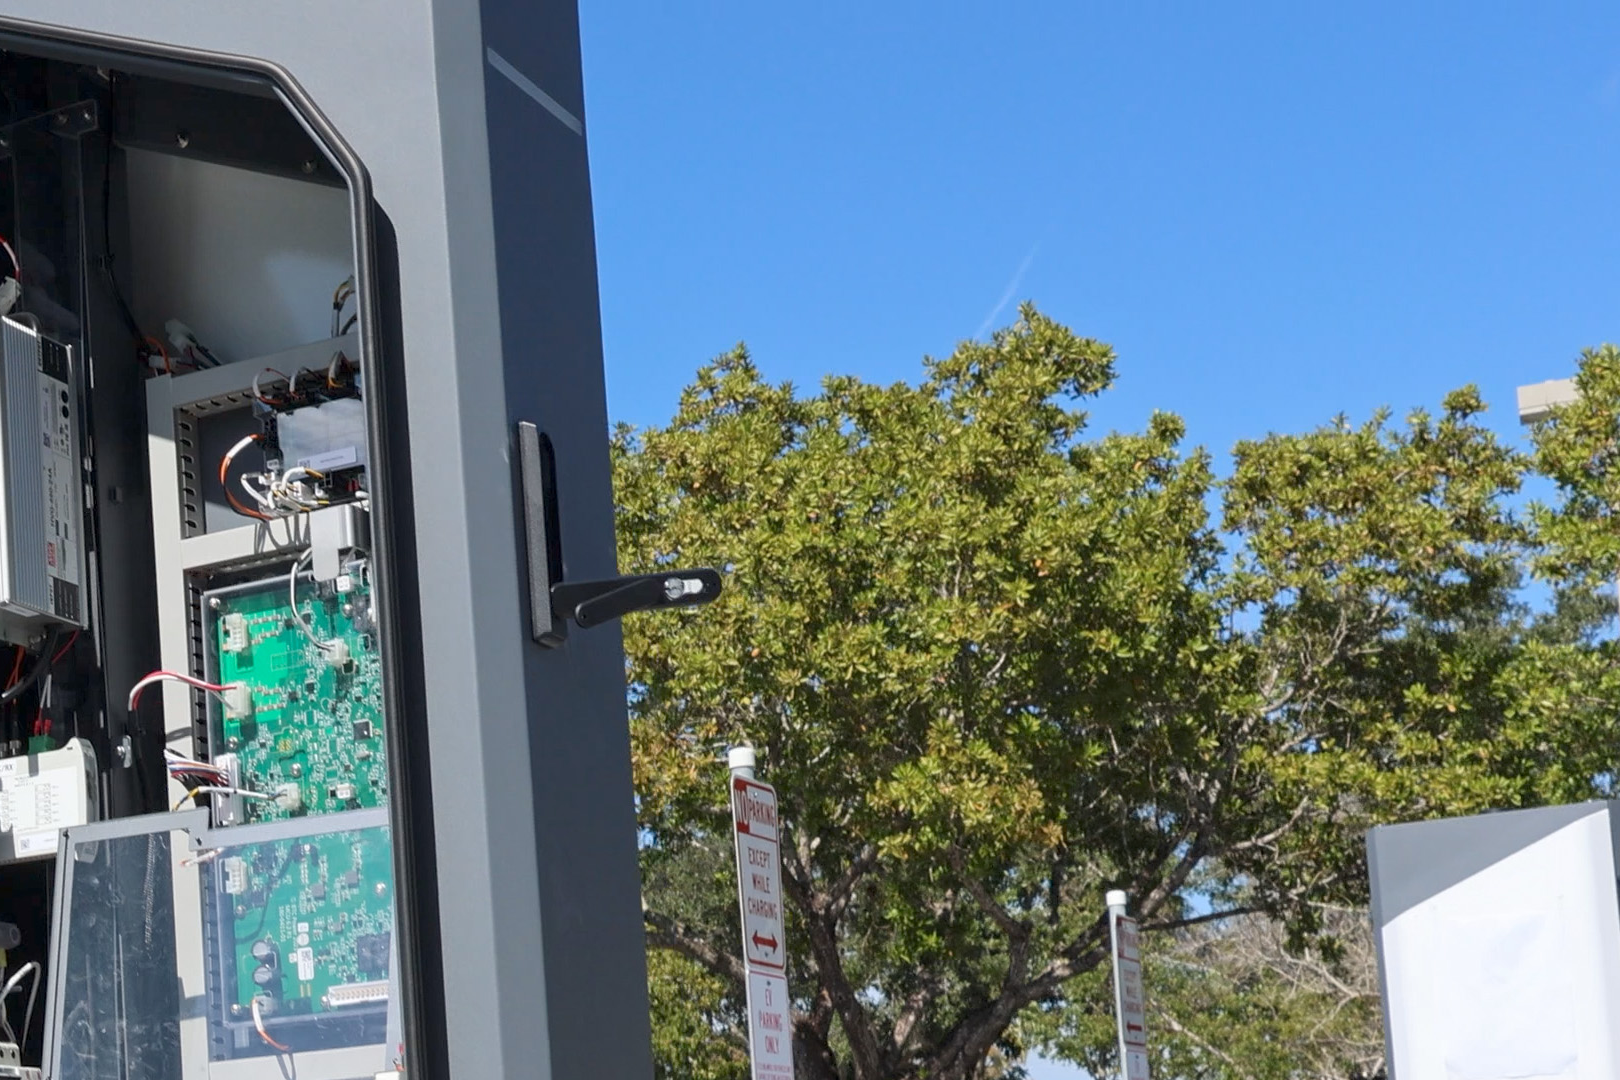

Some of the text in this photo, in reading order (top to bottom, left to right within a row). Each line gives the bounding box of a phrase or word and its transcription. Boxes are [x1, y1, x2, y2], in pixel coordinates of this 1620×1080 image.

[735, 788, 775, 828] NO PARKING
[747, 847, 771, 870] EXCEPT
[751, 873, 771, 894] WHILE
[747, 897, 778, 921] CHARGING
[765, 988, 773, 1007] EV
[758, 1010, 783, 1033] PARKING
[765, 1035, 780, 1055] ONLY
